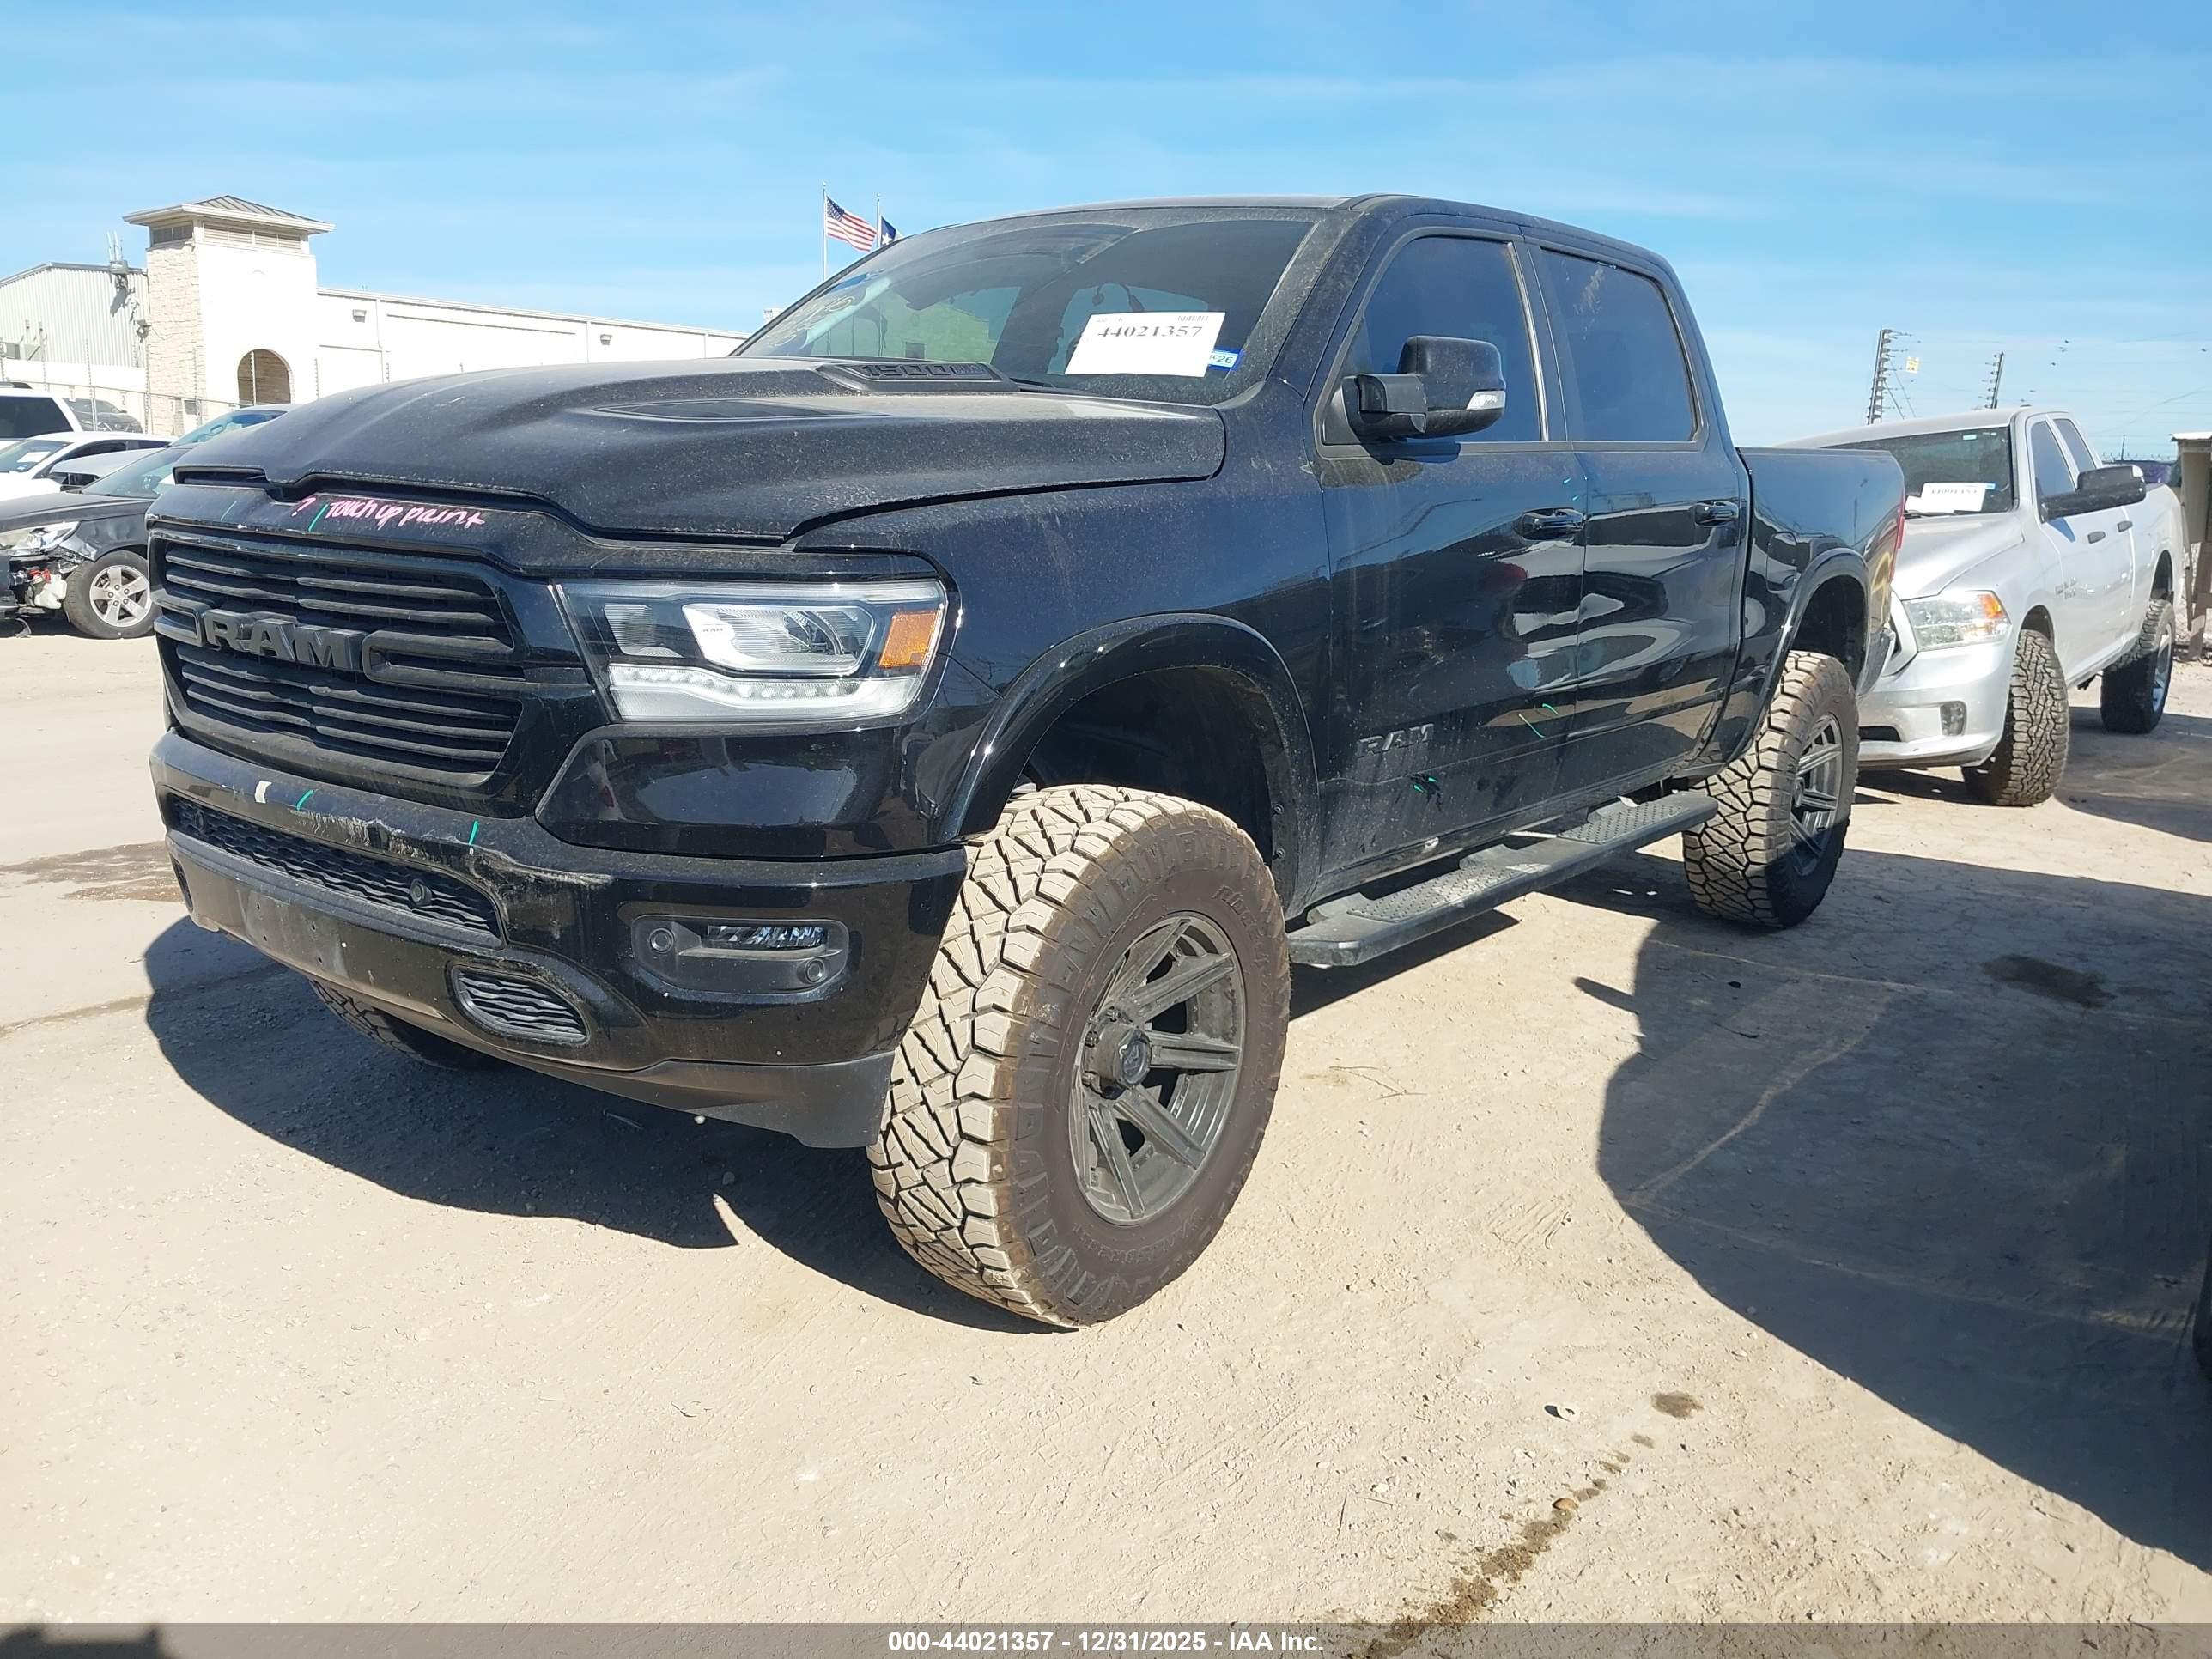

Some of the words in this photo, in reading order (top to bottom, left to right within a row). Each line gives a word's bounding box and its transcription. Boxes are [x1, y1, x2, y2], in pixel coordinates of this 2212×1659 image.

[1097, 325, 1203, 338] 44021357
[204, 609, 367, 672] RAM
[1356, 723, 1435, 758] RAM
